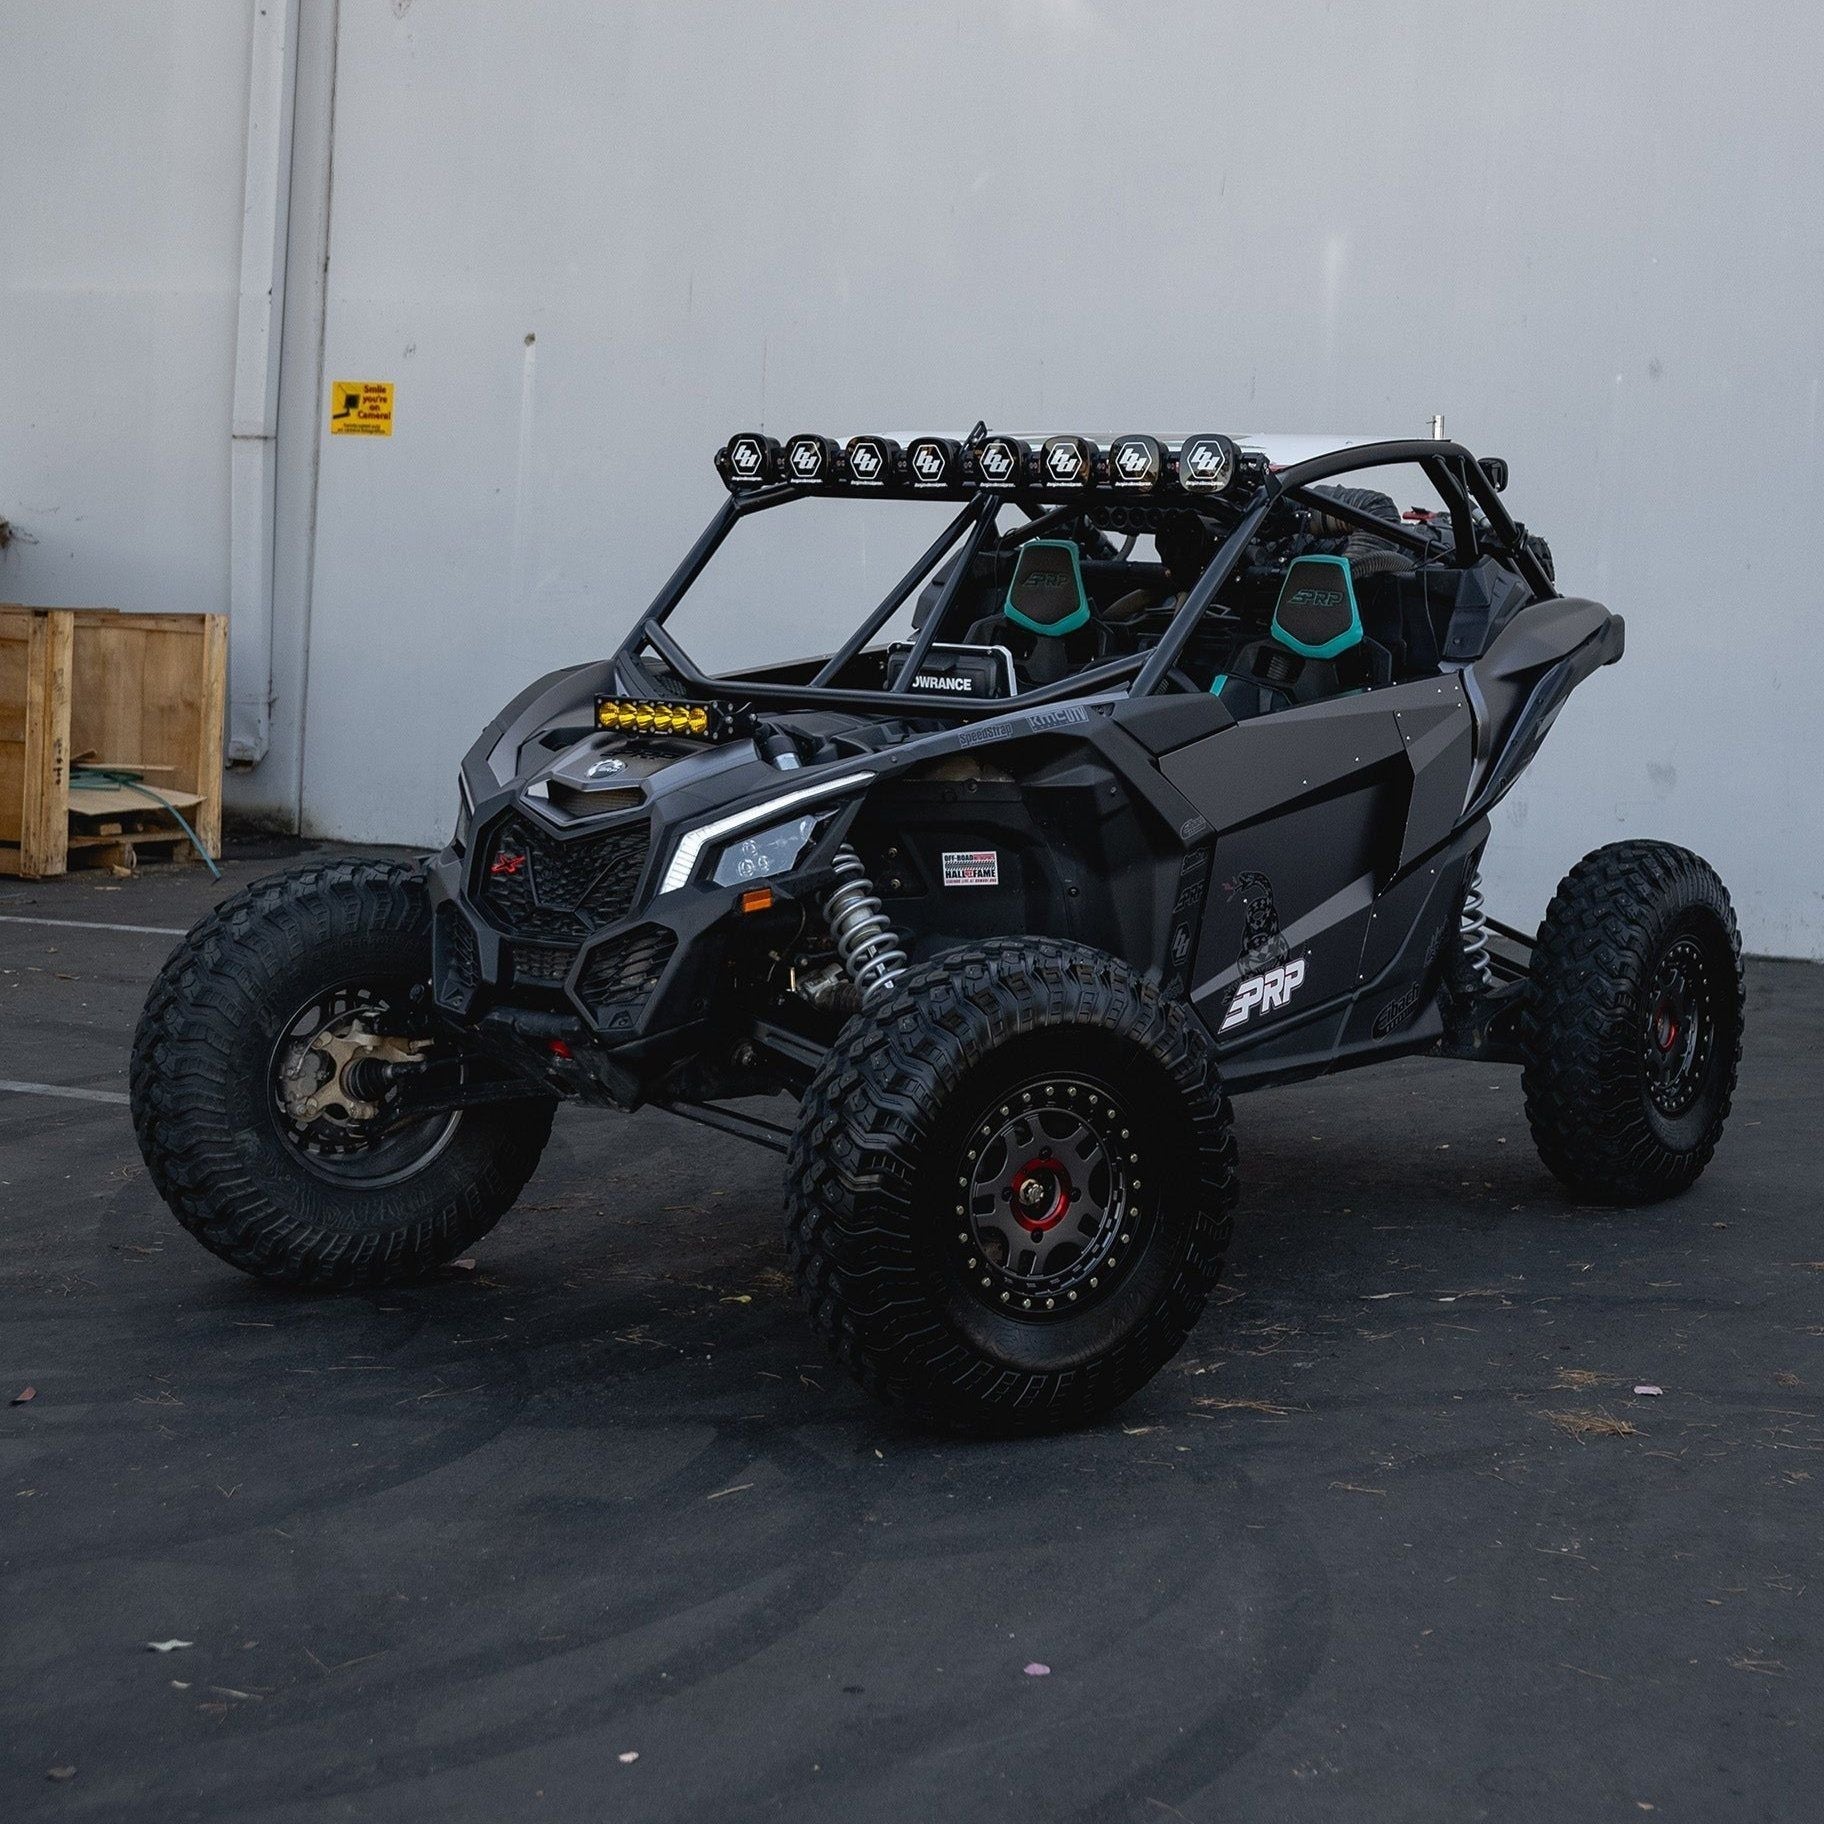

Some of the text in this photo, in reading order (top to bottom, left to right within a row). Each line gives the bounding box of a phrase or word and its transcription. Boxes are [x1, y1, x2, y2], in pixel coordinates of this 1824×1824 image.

[364, 384, 387, 393] Smile
[358, 410, 391, 419] Camera!
[911, 676, 972, 691] OWRANCE
[945, 870, 965, 878] HALL
[973, 869, 996, 877] FAME
[1221, 959, 1305, 1030] PRP
